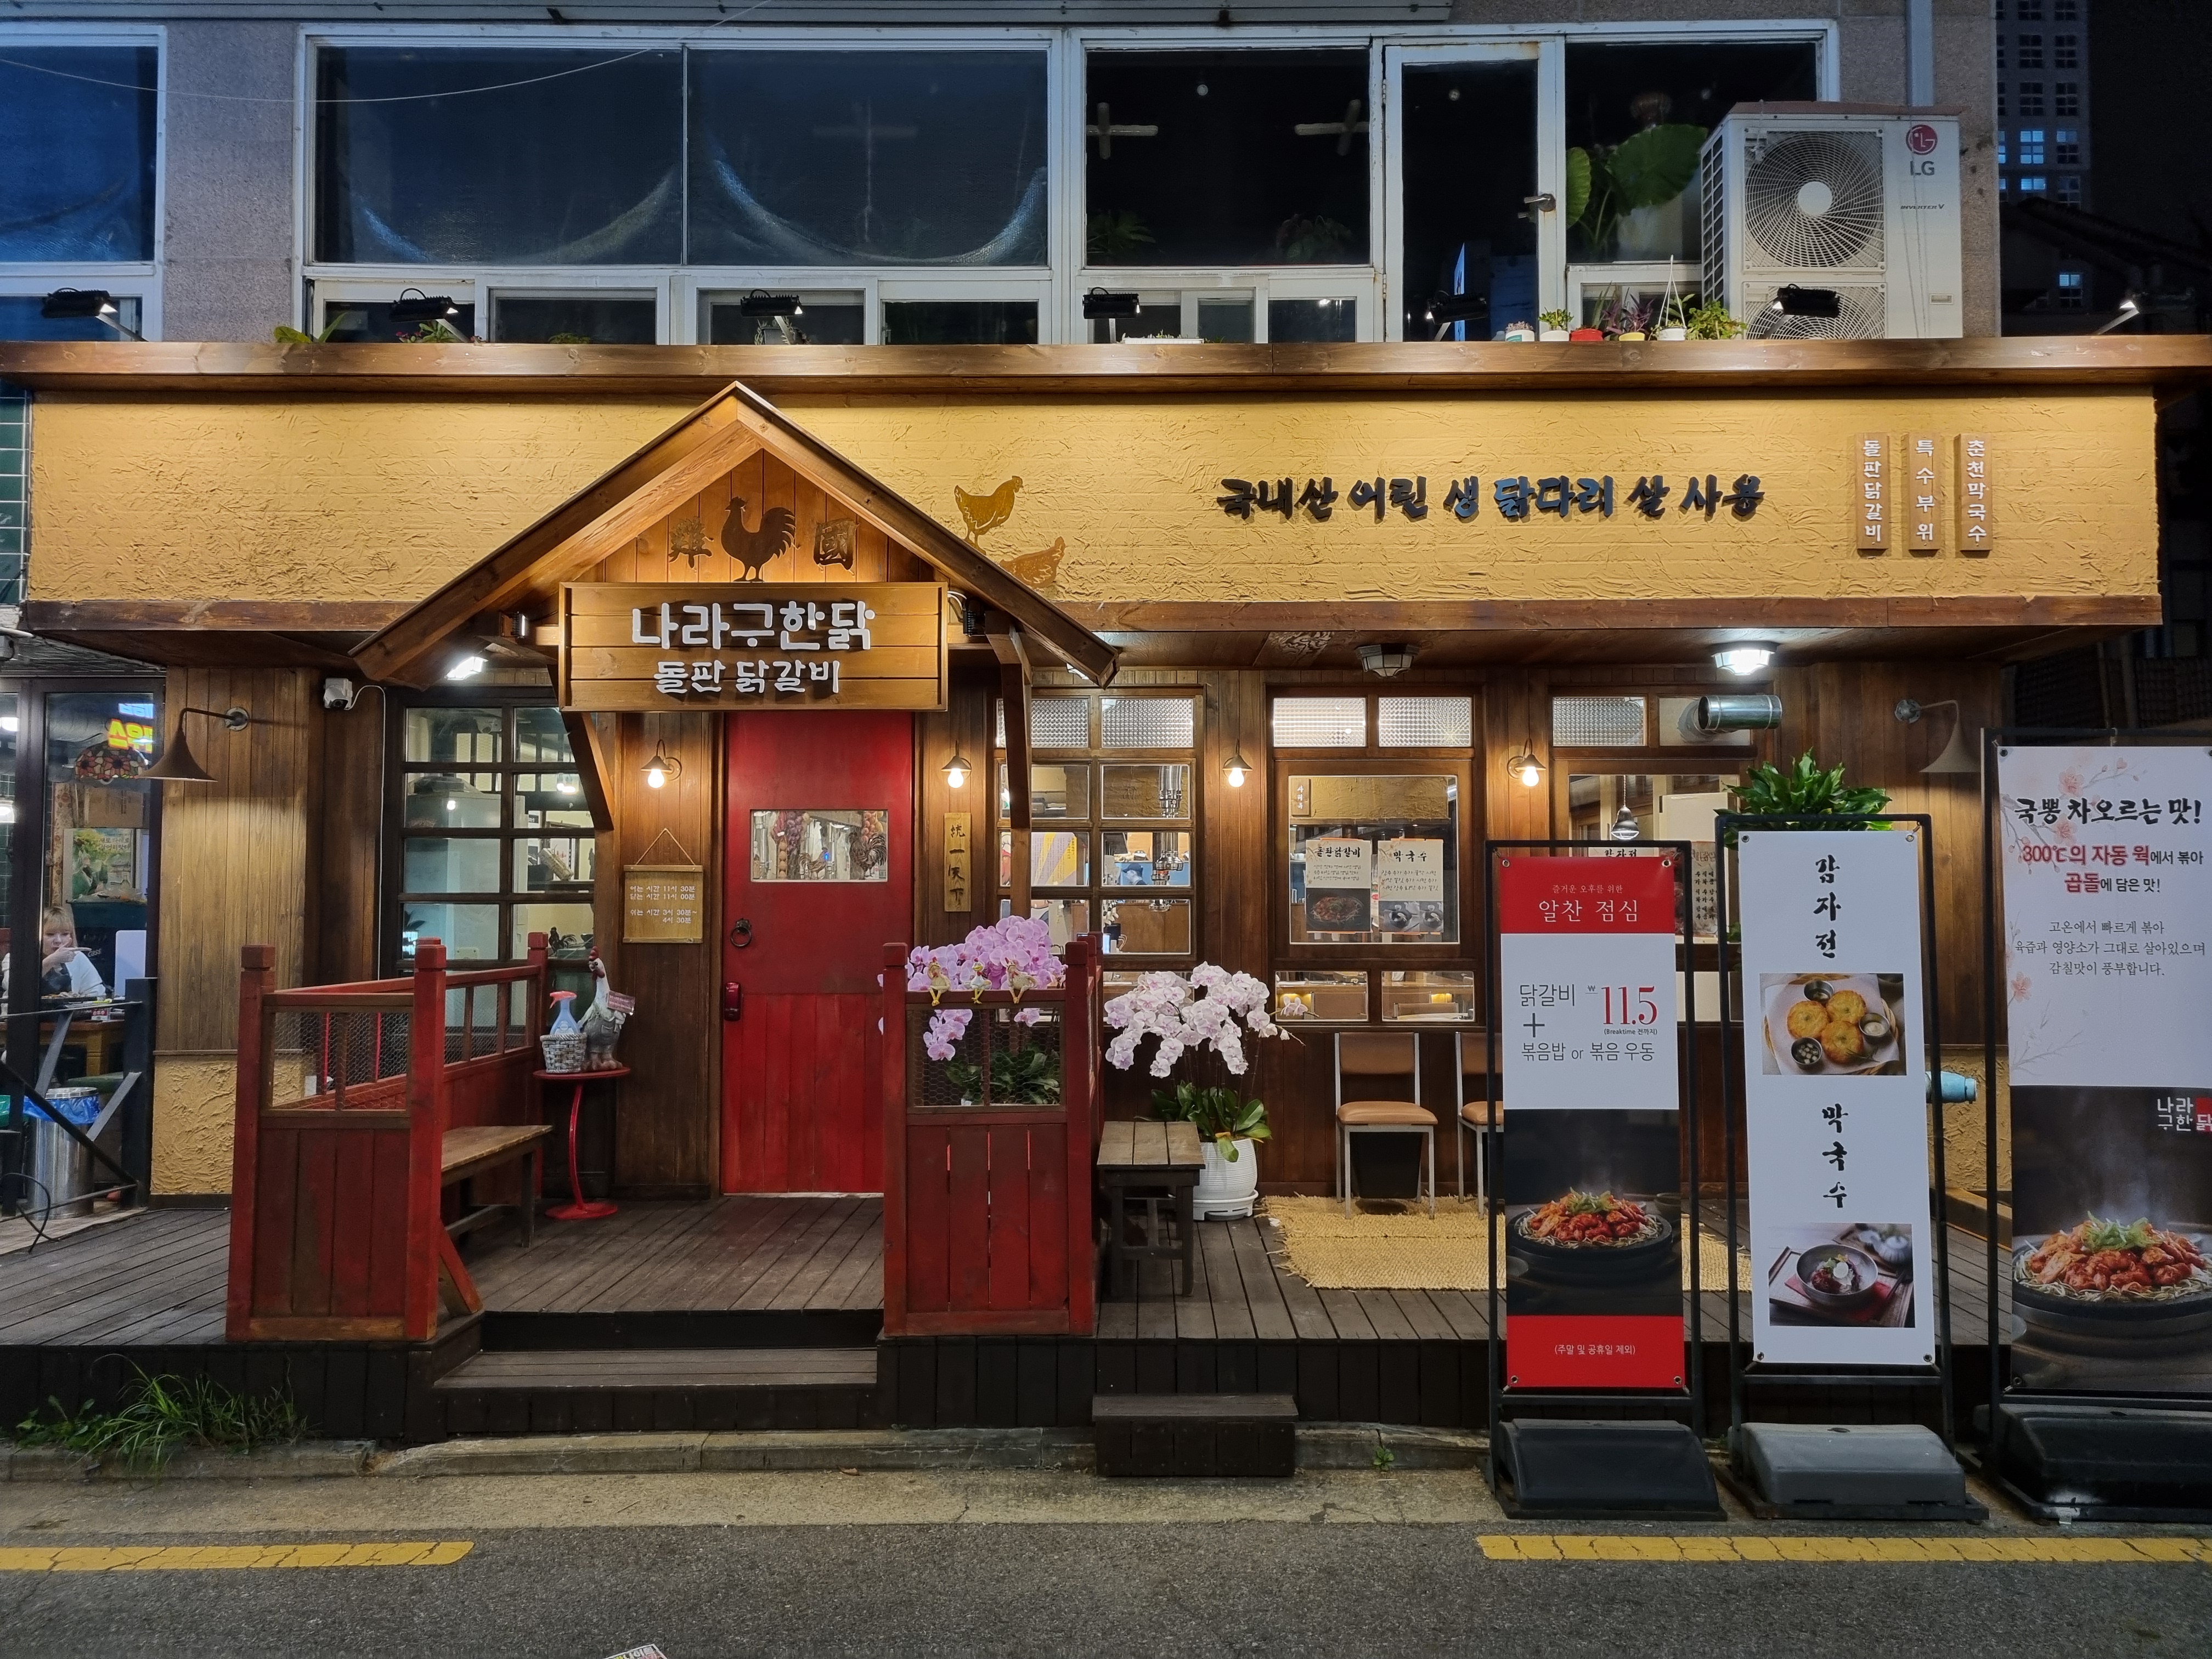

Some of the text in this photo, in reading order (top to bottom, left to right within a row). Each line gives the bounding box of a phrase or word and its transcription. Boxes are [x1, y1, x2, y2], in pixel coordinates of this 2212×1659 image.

[1910, 161, 1935, 176] LG
[1217, 476, 1338, 520] 국내산
[1349, 476, 1427, 520] 어린
[1444, 475, 1480, 518] 생
[1627, 475, 1667, 516] 살
[1679, 473, 1764, 516] 사용
[1863, 439, 1882, 542] 돌판닭갈비
[1916, 439, 1935, 540] 특수부위
[1967, 439, 1987, 542] 춘천막국수
[631, 600, 875, 651] 나라구한닭
[653, 659, 840, 694] 돌판 닭갈비
[2015, 797, 2202, 825] 국뽕 차오르는 맛!
[1393, 850, 1427, 862] 막국수
[2092, 845, 2128, 866] 자동
[2132, 845, 2173, 866] 웍에서
[2177, 851, 2204, 865] 볶아
[1553, 884, 1623, 894] 즐거운 오후를 위한
[2064, 872, 2160, 893] 곱돌에 담은 맛!
[1539, 900, 1638, 922] 알찬 점심
[1813, 854, 1842, 959] 감자전
[2049, 920, 2164, 934] 고온에서 빠르게 볶아
[2015, 940, 2205, 956] 육즙과 영양소가 그대로 살아있으며
[2049, 961, 2165, 977] 감칠맛이 풍부합니다.
[1520, 984, 1575, 1007] 닭갈비
[1601, 985, 1658, 1025] 11.5
[1521, 1042, 1655, 1062] 볶음밥 or 볶음 우동
[2157, 1096, 2194, 1114] 나라
[1821, 1103, 1849, 1209] 막국수
[1554, 1344, 1636, 1355] (주말 및 공휴일 제외)
